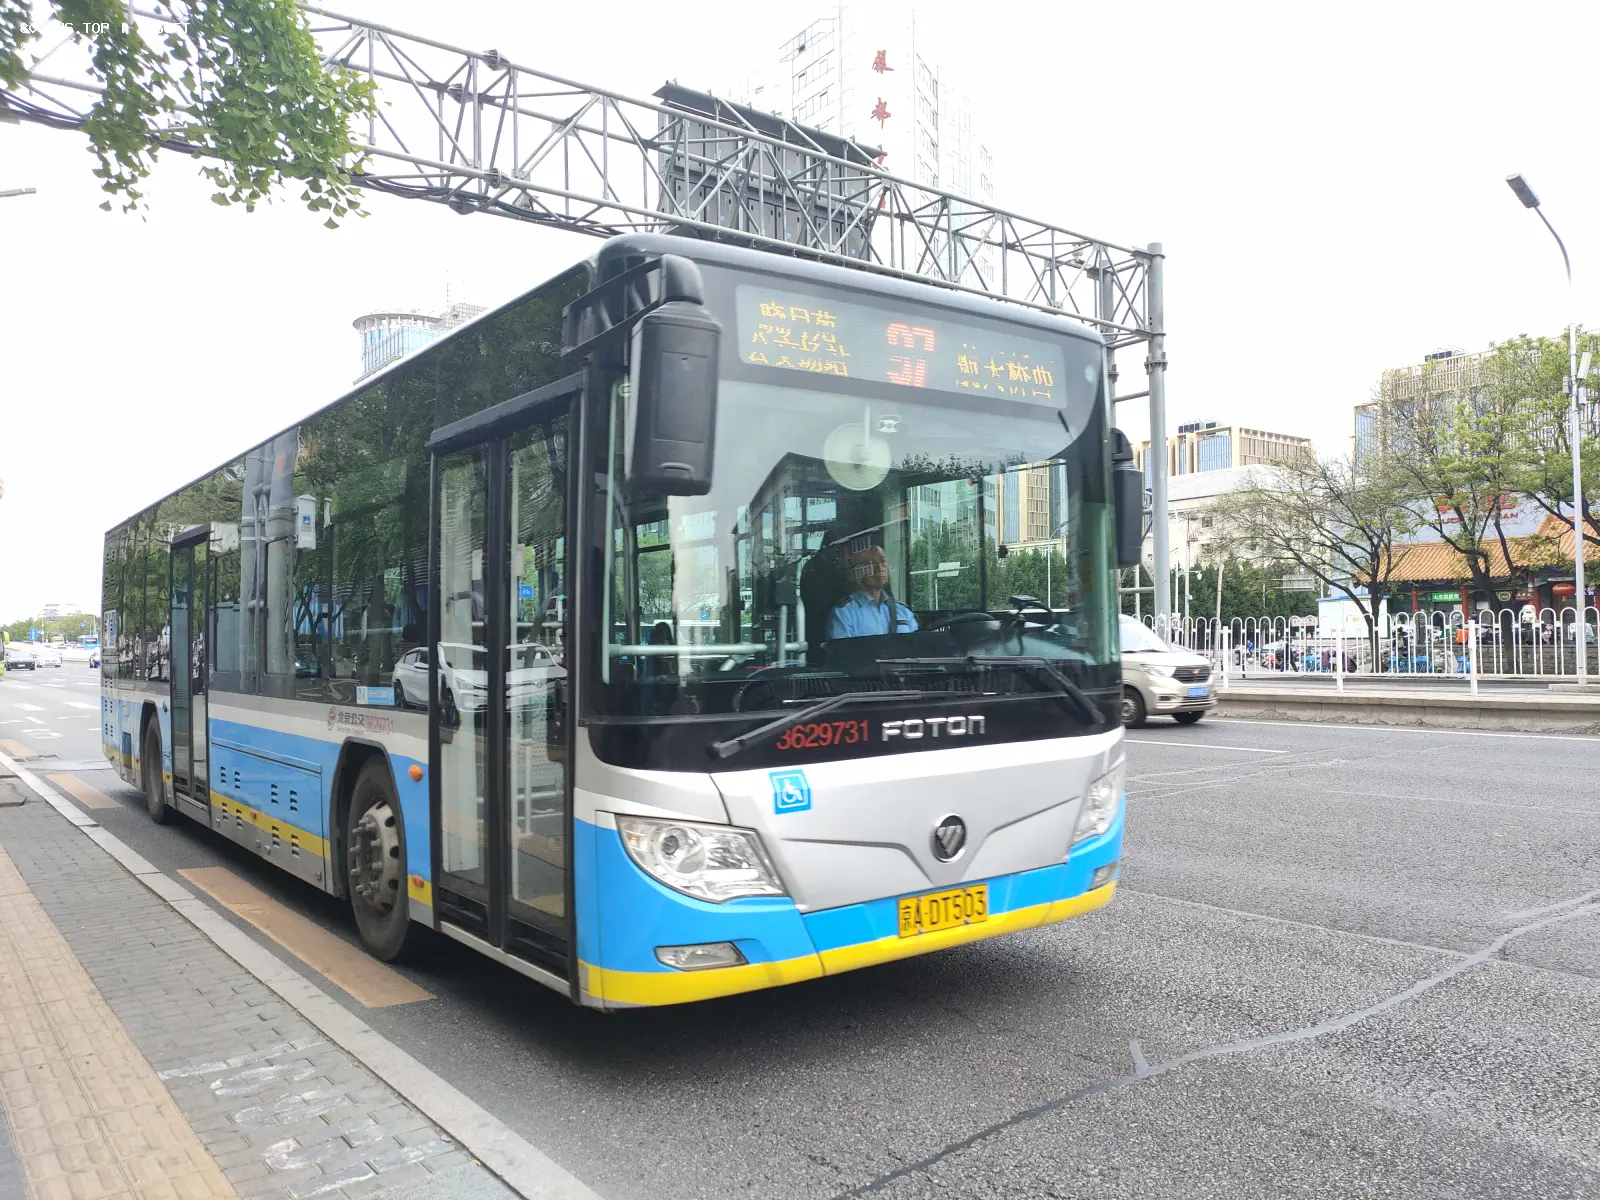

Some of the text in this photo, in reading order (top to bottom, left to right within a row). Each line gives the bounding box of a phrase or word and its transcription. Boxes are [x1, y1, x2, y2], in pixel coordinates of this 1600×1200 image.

[338, 711, 365, 726] 北京公交
[881, 715, 986, 742] FOTON
[776, 720, 869, 749] 3629731
